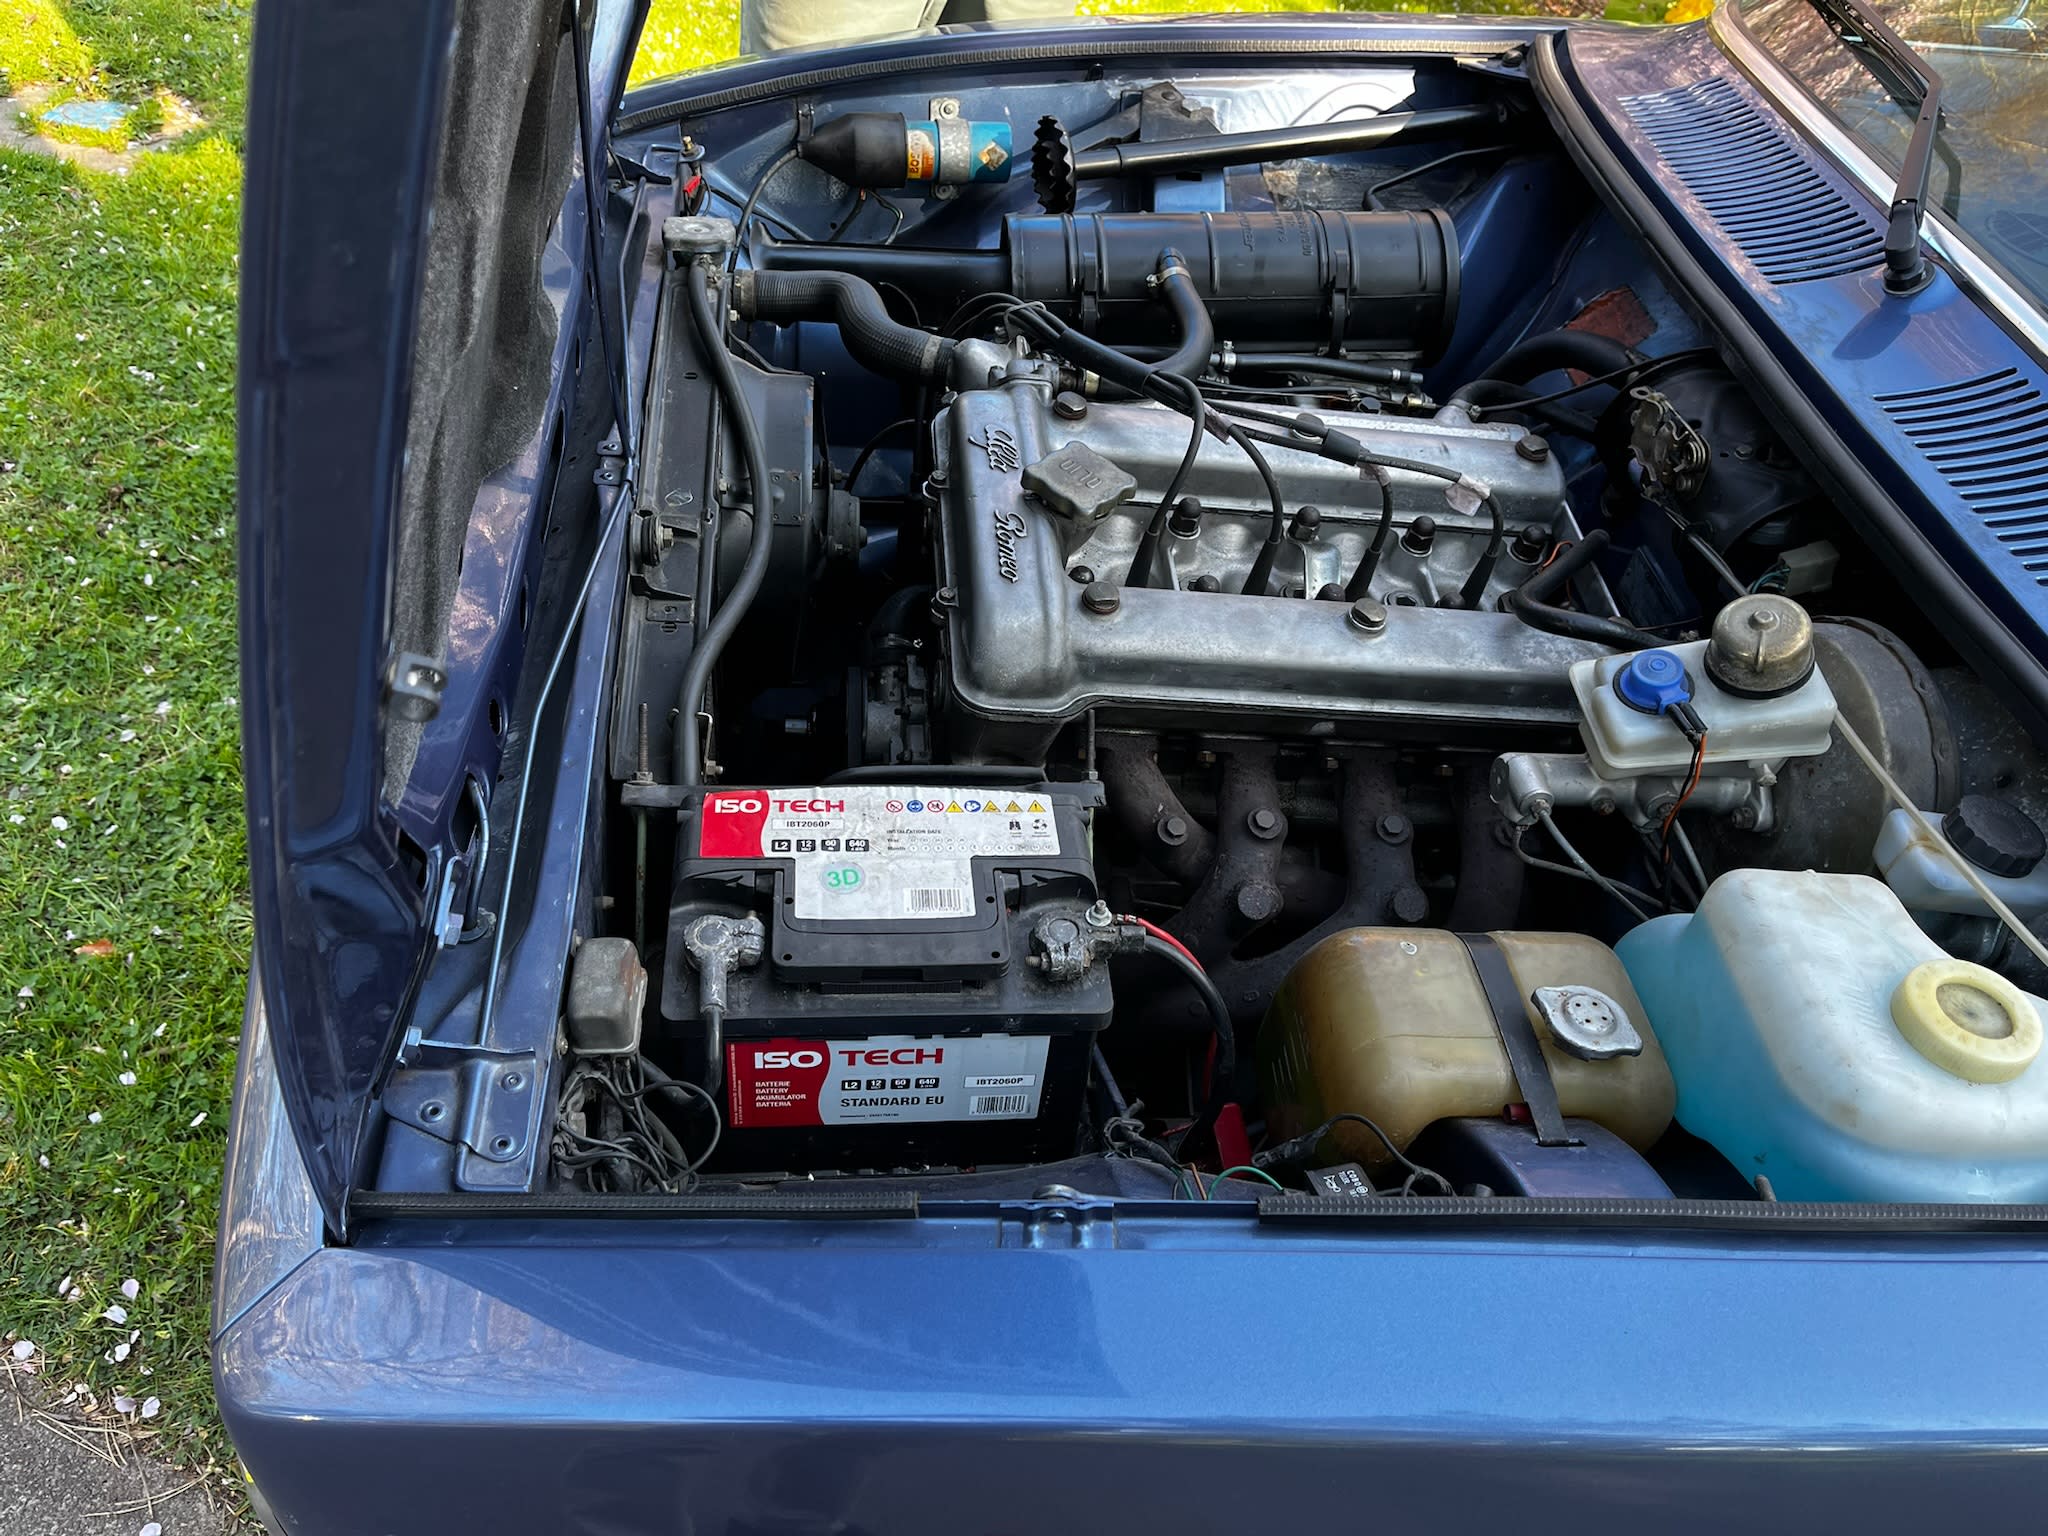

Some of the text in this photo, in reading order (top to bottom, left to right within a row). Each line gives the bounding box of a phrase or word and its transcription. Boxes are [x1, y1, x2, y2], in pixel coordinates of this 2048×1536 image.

[1059, 459, 1103, 489] OLIO
[968, 424, 1028, 583] Alfa Romeo
[714, 799, 845, 813] ISO TECH
[774, 841, 788, 850] L2
[826, 868, 859, 888] 3D
[754, 1048, 944, 1069] ISO TECH
[976, 1077, 1024, 1085] IBT2060P
[840, 1095, 944, 1107] STANDARD EU
